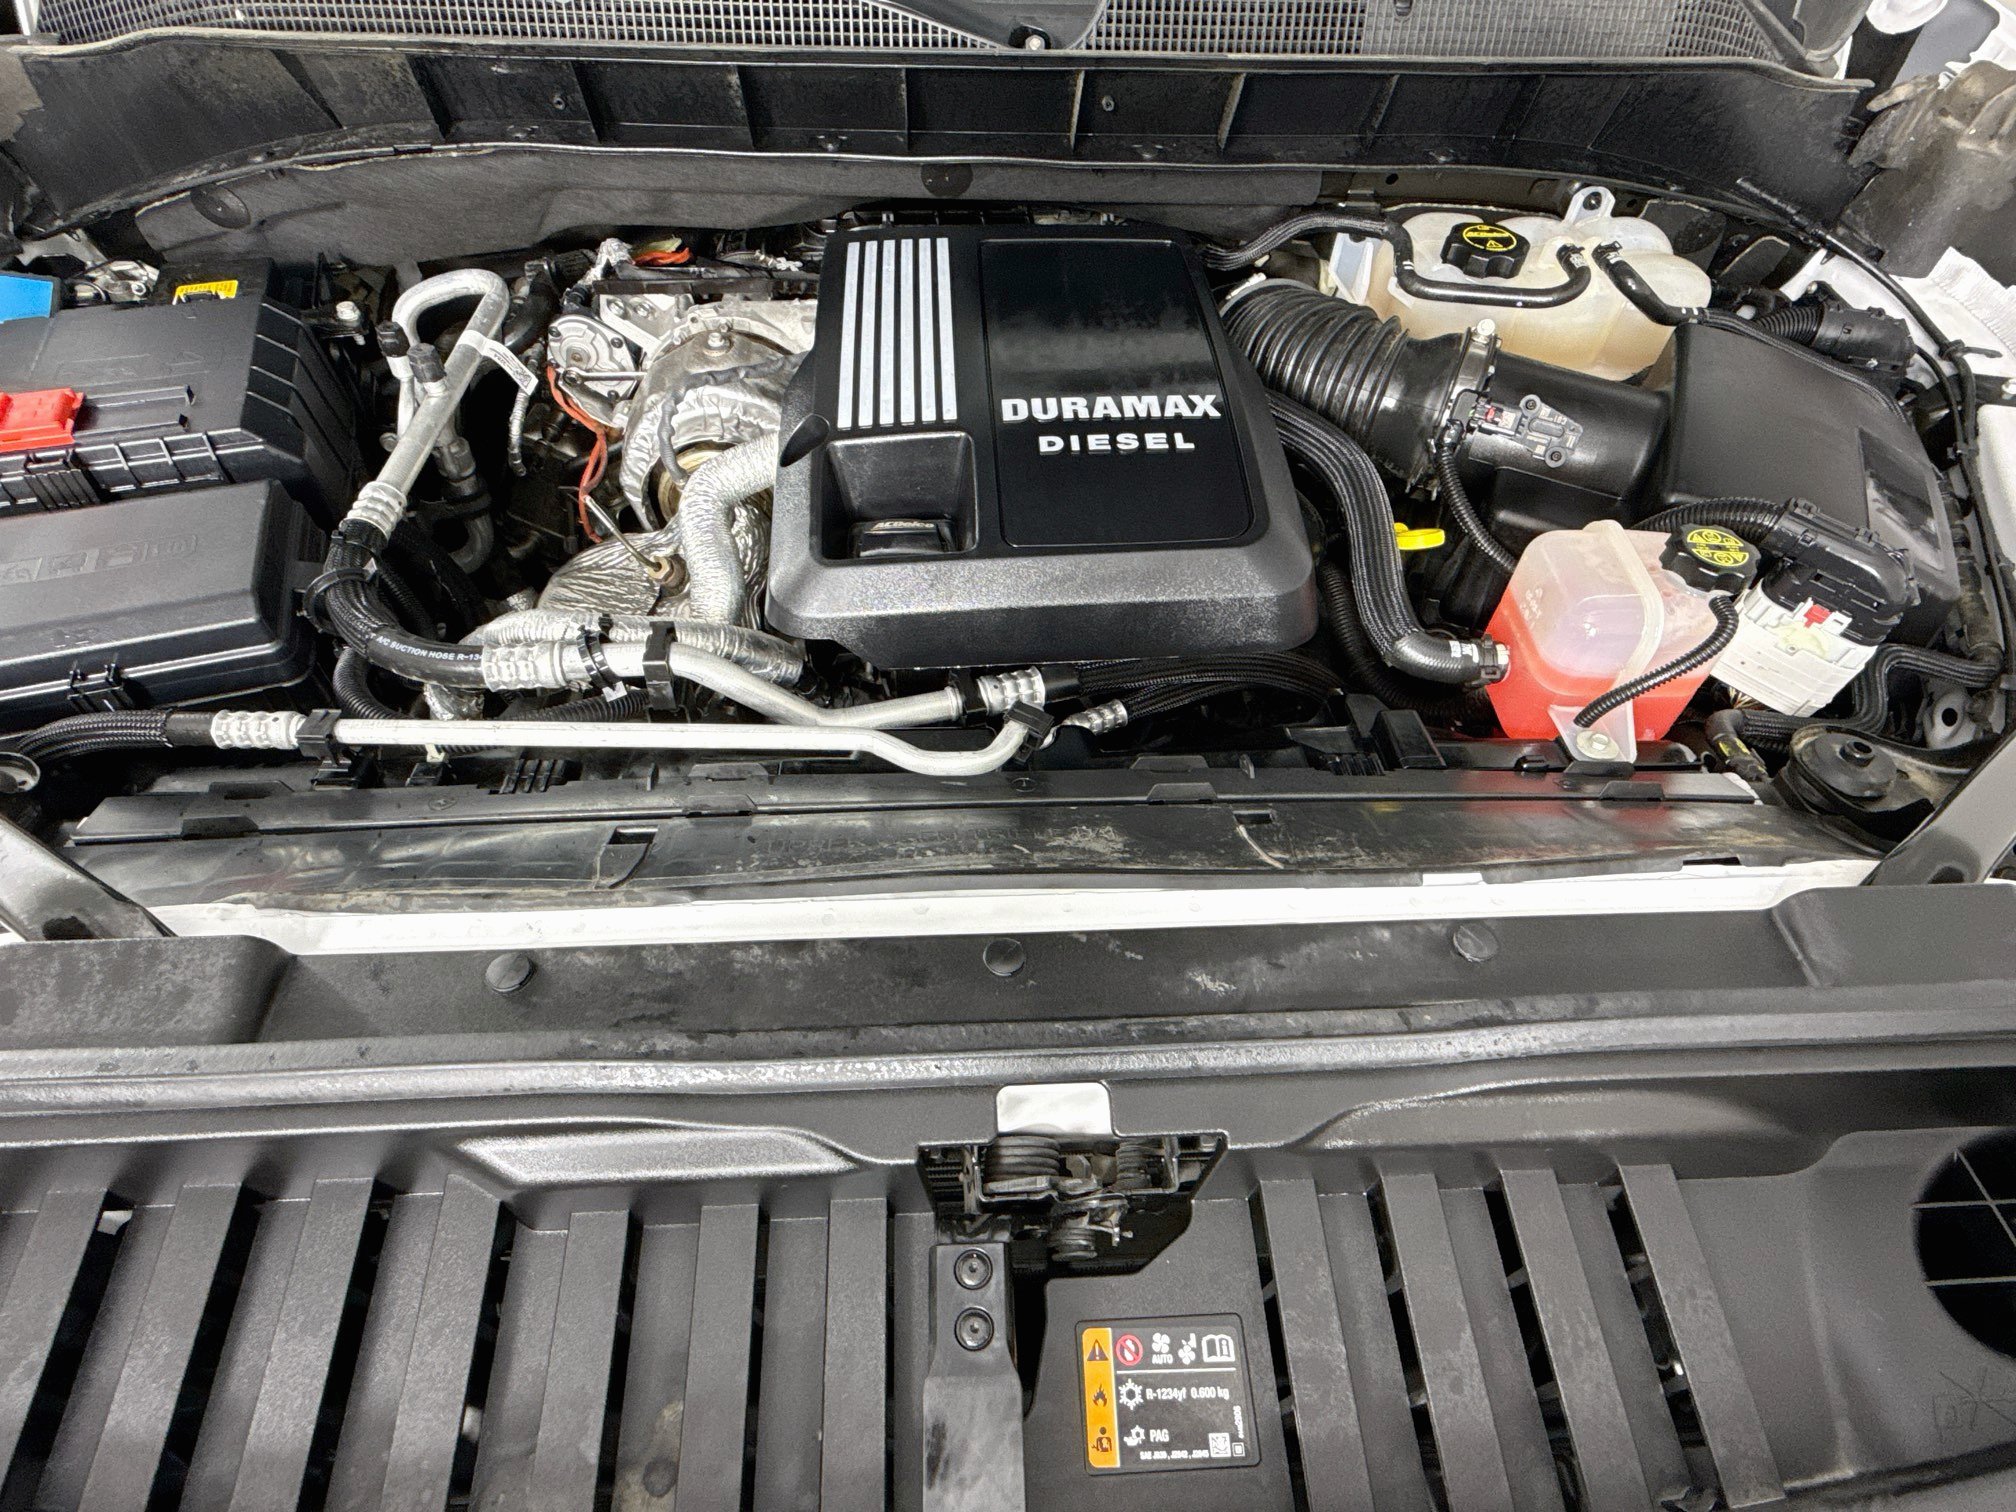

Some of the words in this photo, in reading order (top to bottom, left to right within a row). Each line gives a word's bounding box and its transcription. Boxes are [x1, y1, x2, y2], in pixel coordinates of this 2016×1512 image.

[1001, 394, 1221, 423] DURAMAX
[1038, 432, 1196, 455] DIESEL
[376, 635, 390, 646] A/C
[390, 641, 428, 657] SUCTION
[427, 651, 456, 661] HOSE
[1151, 1353, 1174, 1365] AUTO
[1145, 1386, 1187, 1402] R-1234yf
[1190, 1386, 1217, 1400] 0.600
[1217, 1385, 1230, 1401] kg
[1149, 1428, 1170, 1442] PAG
